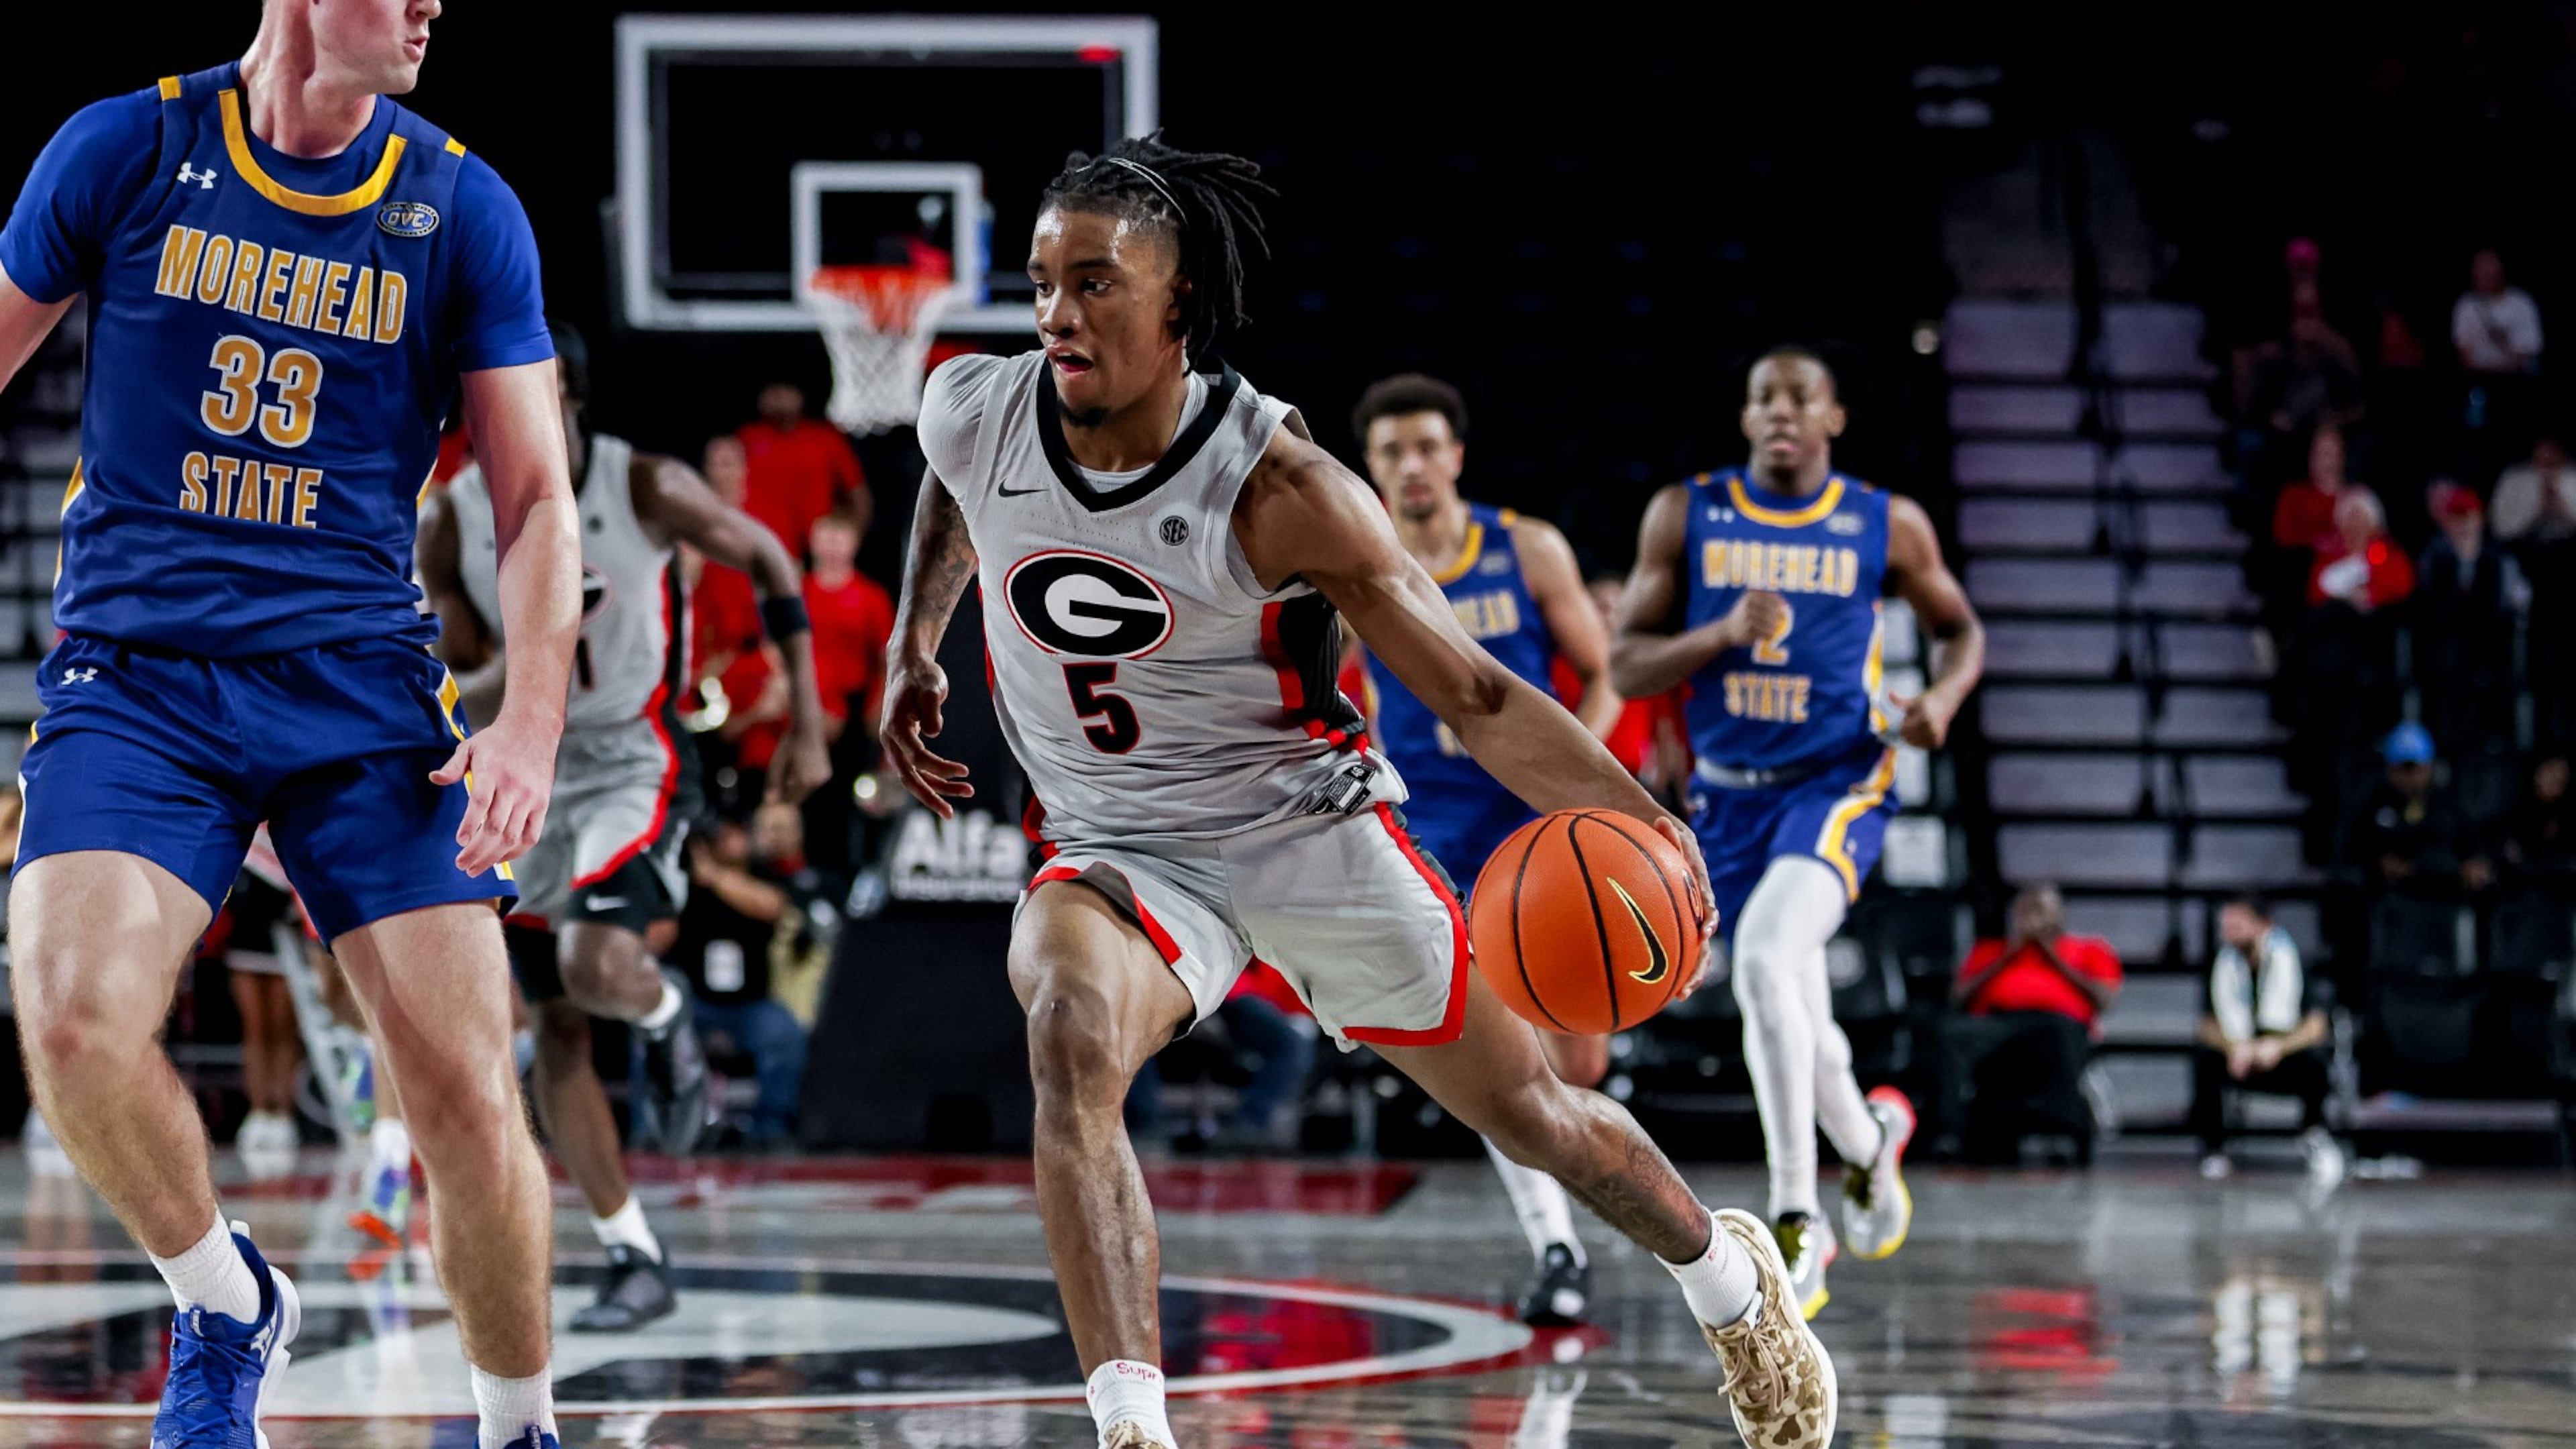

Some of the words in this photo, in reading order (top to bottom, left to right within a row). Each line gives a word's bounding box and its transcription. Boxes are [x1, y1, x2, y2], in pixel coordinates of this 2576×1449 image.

[388, 211, 426, 228] OVC
[155, 224, 407, 344] MOREHEAD
[201, 334, 323, 448] 33
[179, 451, 323, 529] STATE
[1163, 519, 1187, 543] SEC
[1008, 553, 1168, 657] G
[1703, 540, 1858, 597] MOREHEAD
[1062, 661, 1140, 755] 5
[1724, 673, 1811, 722] STATE
[893, 809, 1026, 877] Alfa
